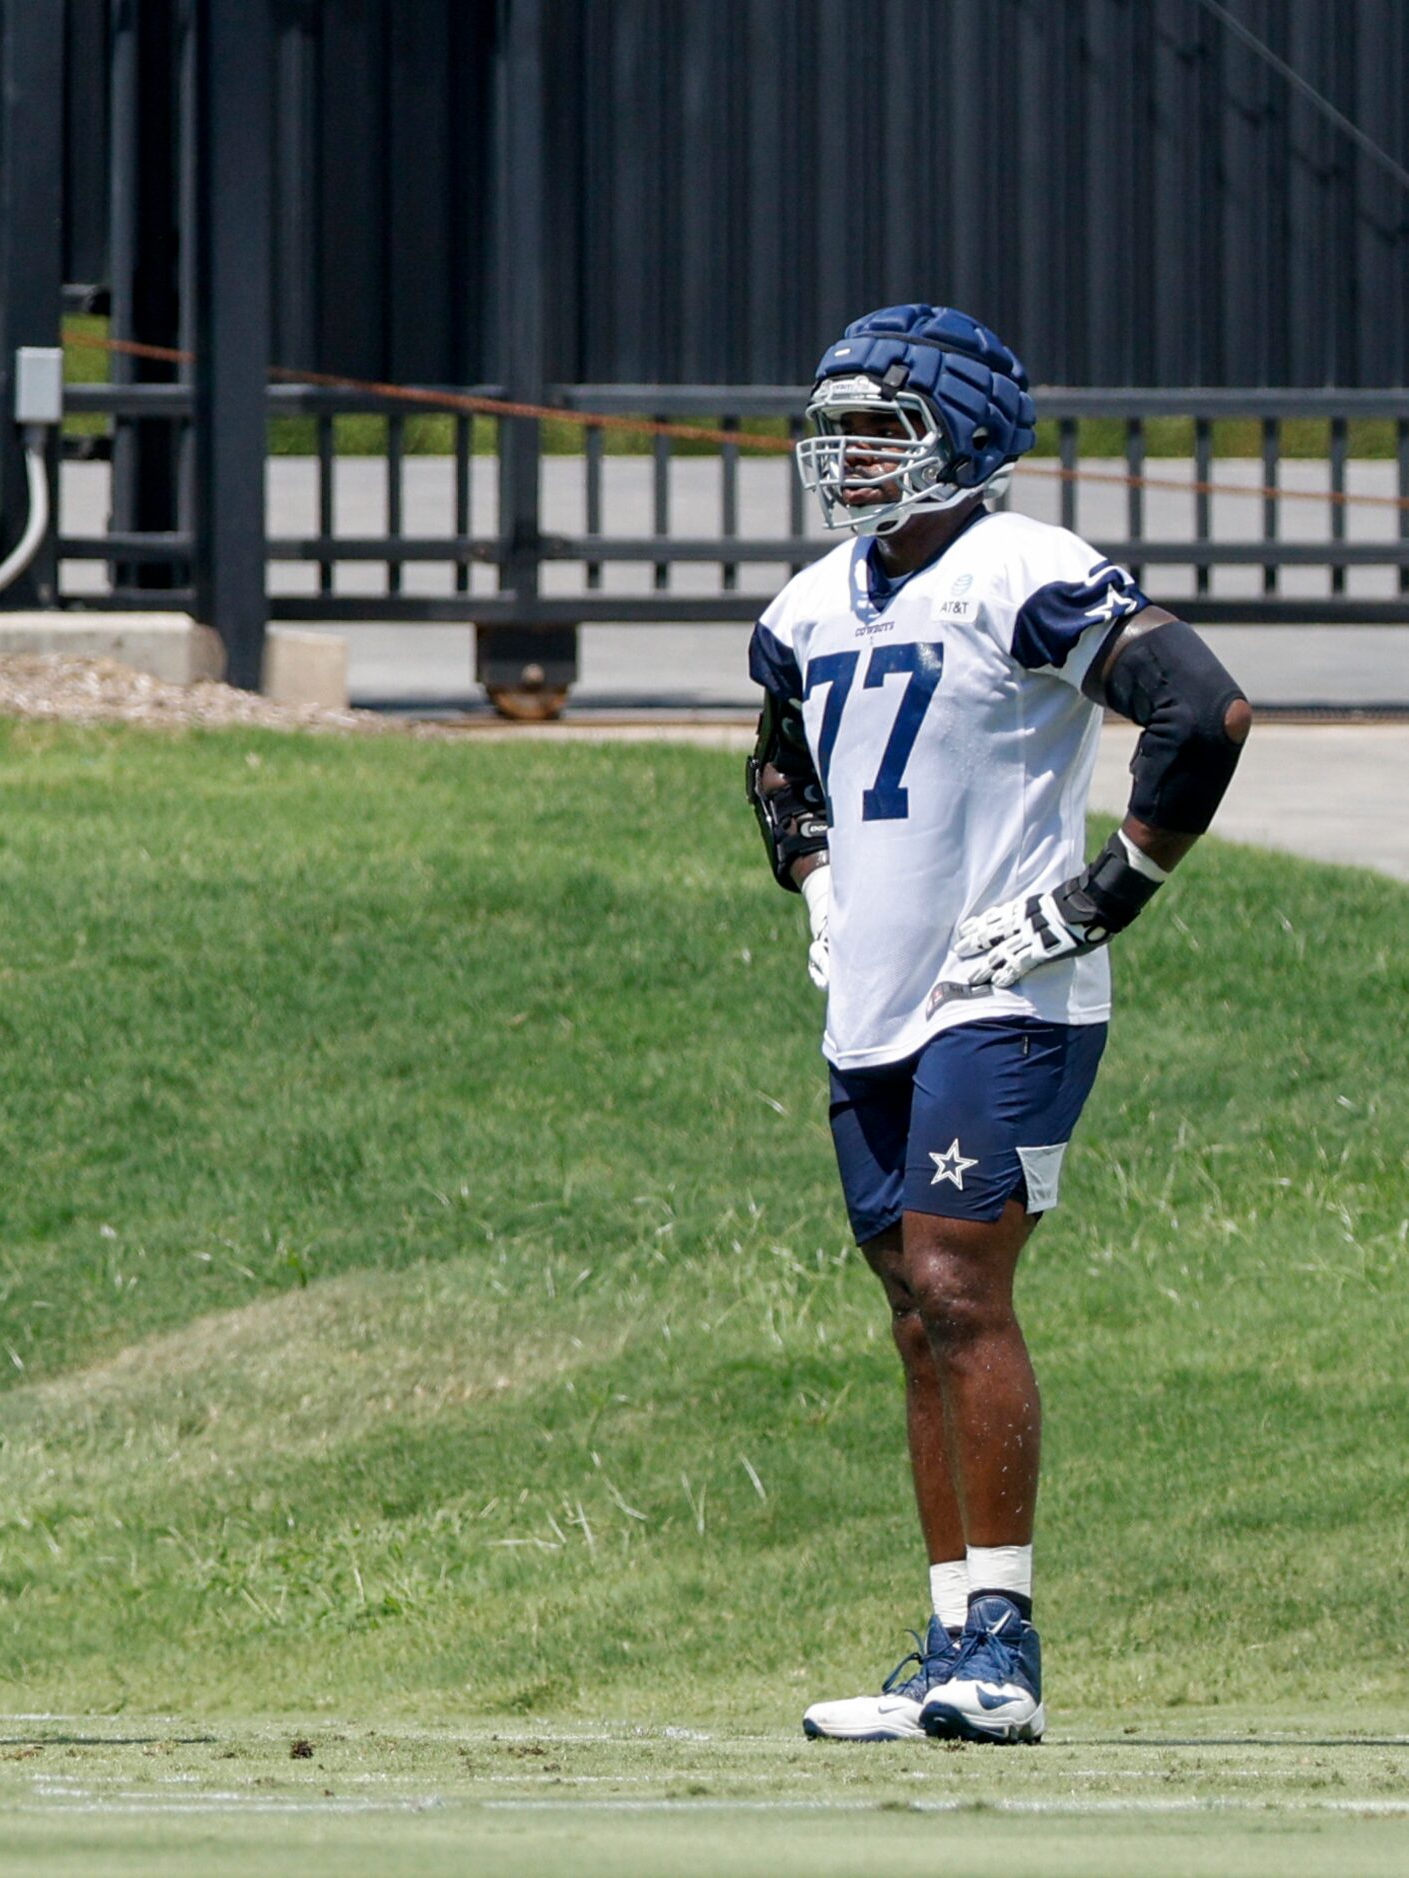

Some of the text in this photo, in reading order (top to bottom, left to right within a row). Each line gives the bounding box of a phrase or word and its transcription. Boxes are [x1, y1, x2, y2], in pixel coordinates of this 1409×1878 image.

[939, 602, 969, 615] AT&T
[855, 621, 895, 637] COWBOYS
[803, 641, 944, 828] 77
